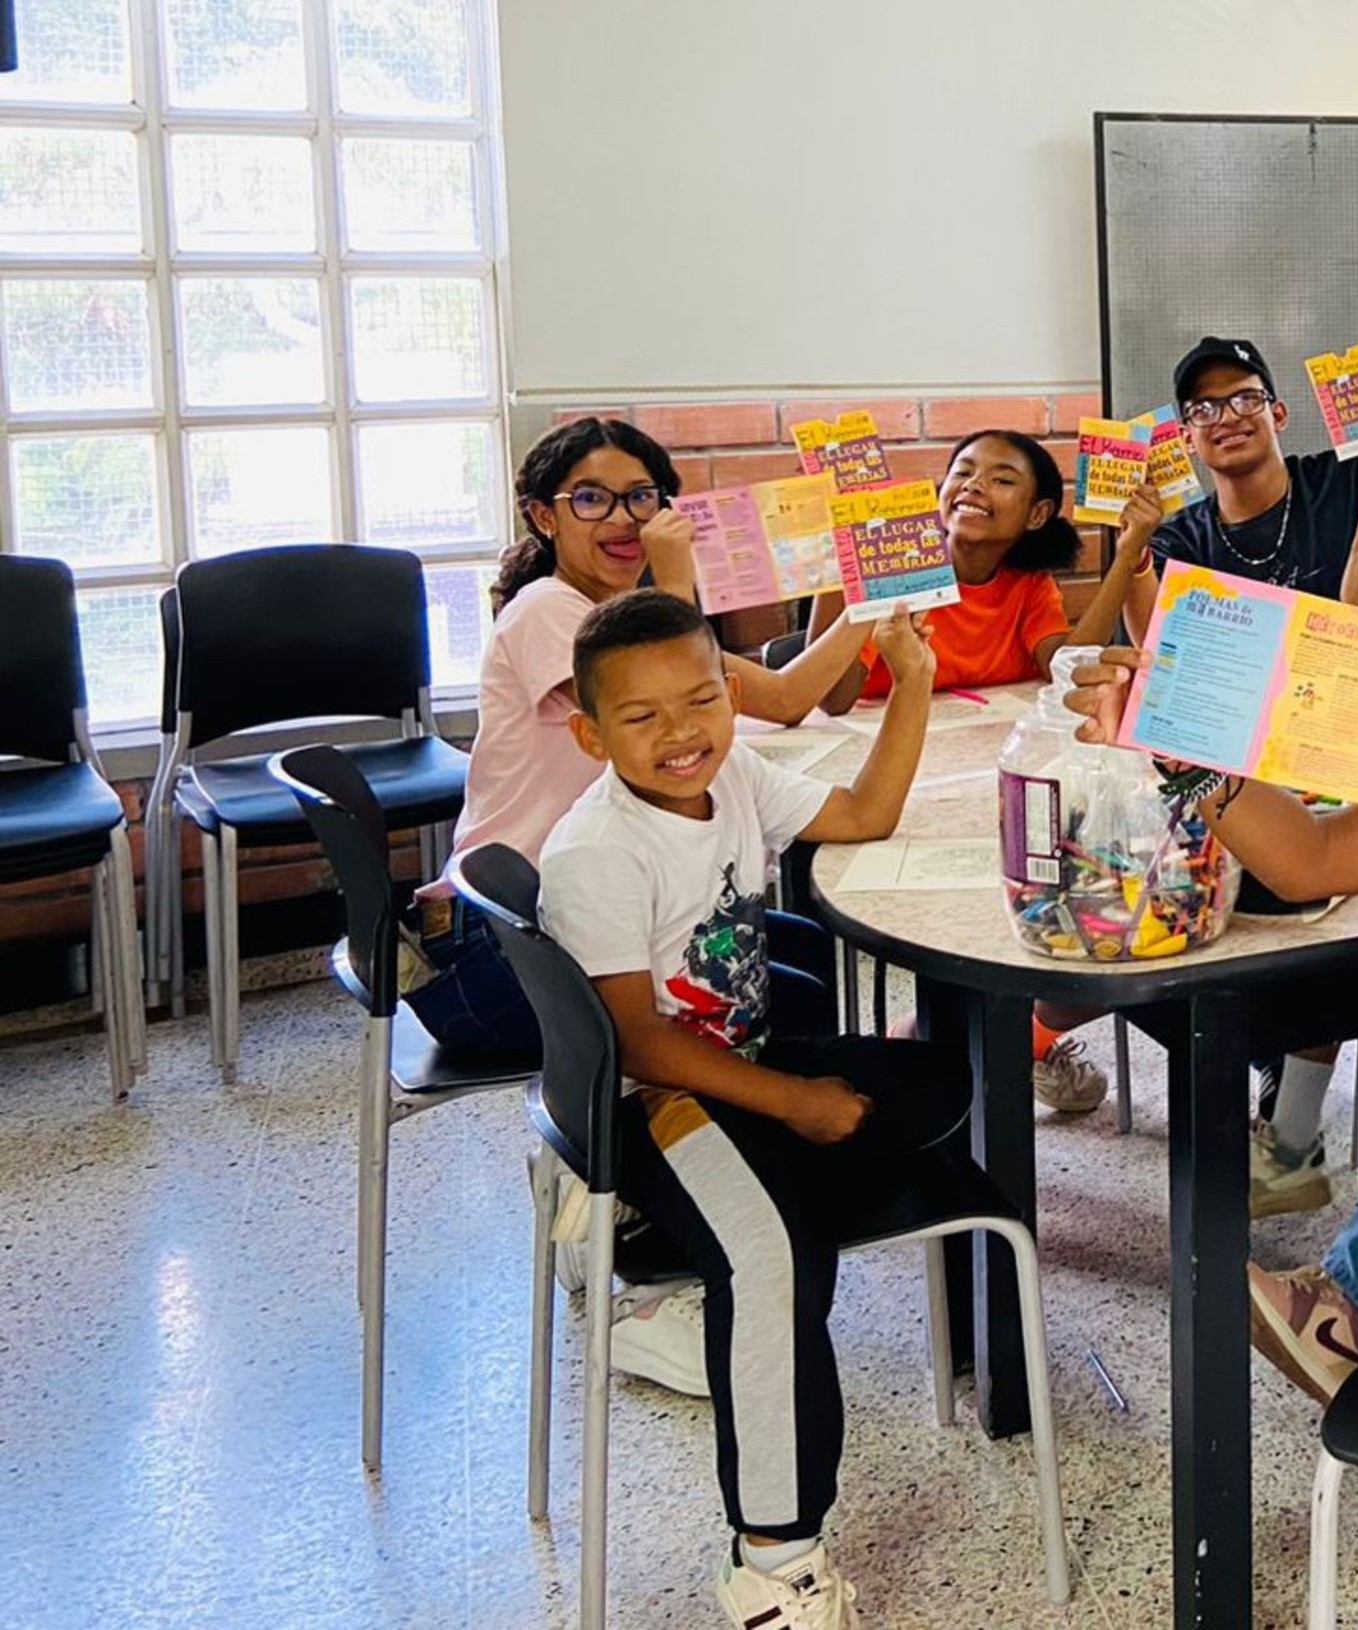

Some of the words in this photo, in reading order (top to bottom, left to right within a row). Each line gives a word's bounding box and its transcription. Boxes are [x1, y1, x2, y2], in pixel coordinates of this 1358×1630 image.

[855, 526, 878, 542] EL
[881, 518, 937, 538] LUGAR
[858, 543, 876, 558] de
[879, 536, 918, 554] todas
[920, 533, 941, 549] las
[1207, 607, 1254, 626] BARRIO
